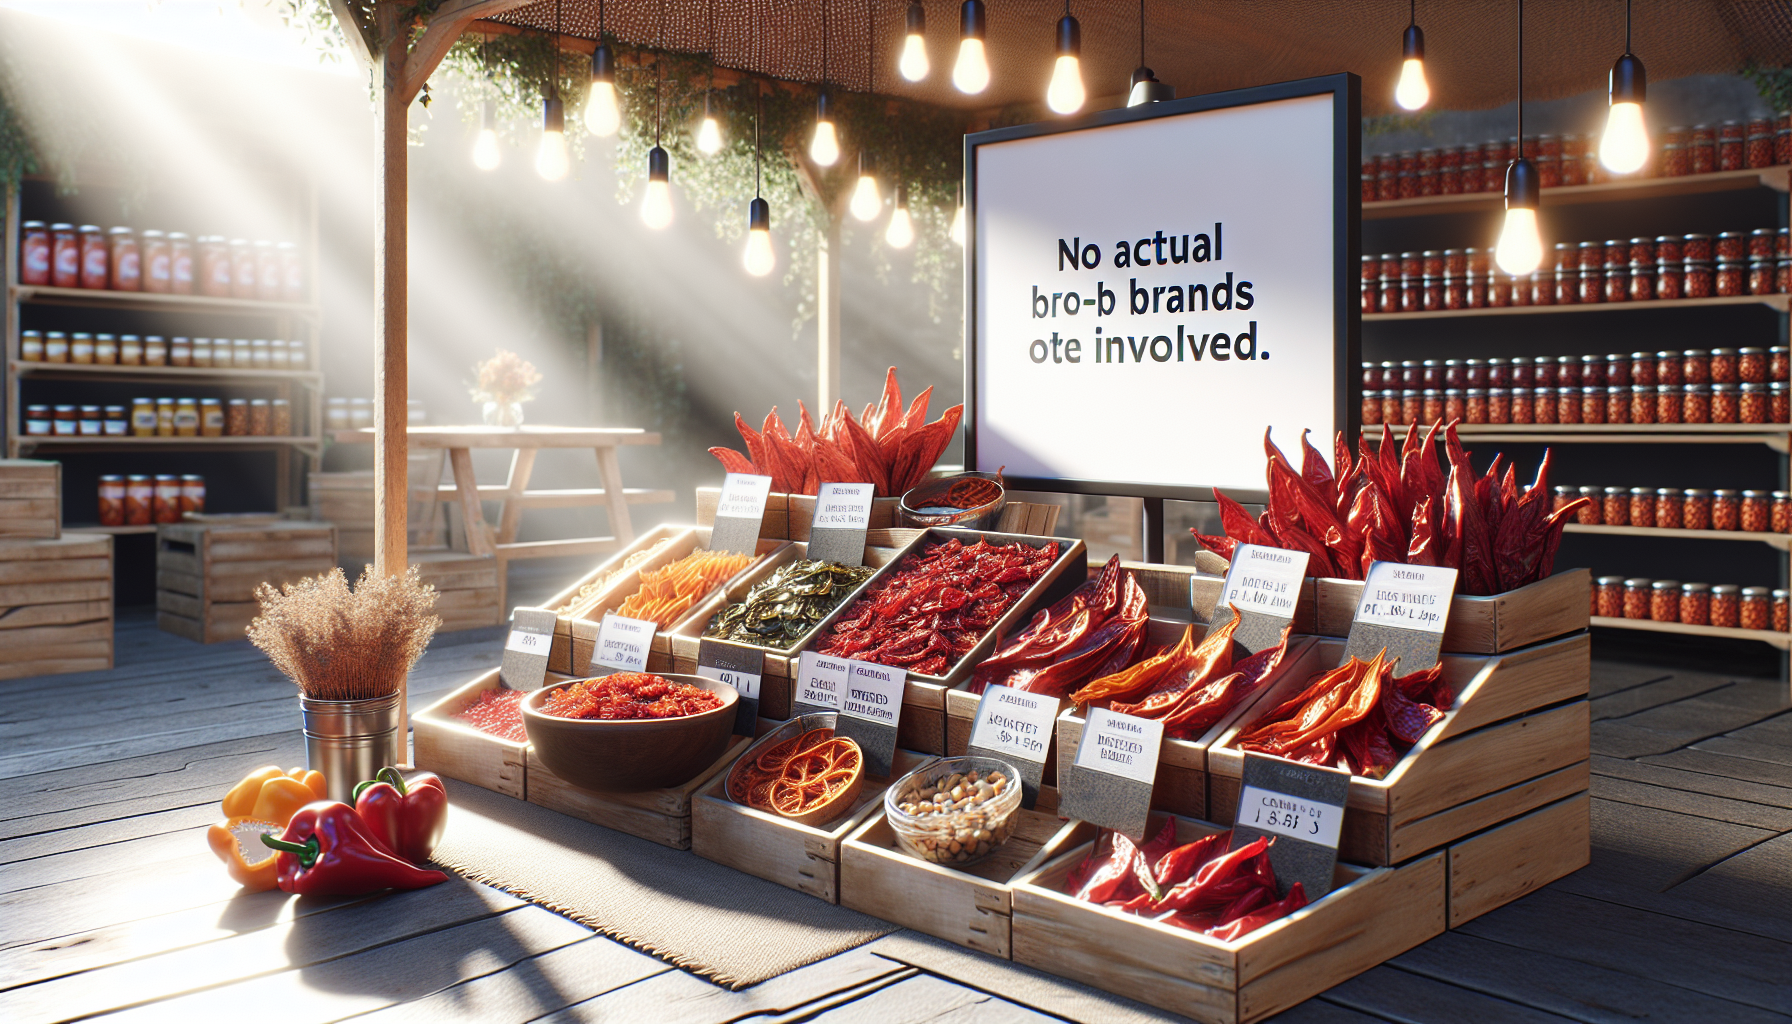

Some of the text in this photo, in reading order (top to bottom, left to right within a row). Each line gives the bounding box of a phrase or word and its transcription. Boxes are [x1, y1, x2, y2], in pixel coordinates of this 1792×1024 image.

[1058, 222, 1222, 271] No actual
[1032, 272, 1254, 319] bro-b brands
[1095, 321, 1270, 364] involved.
